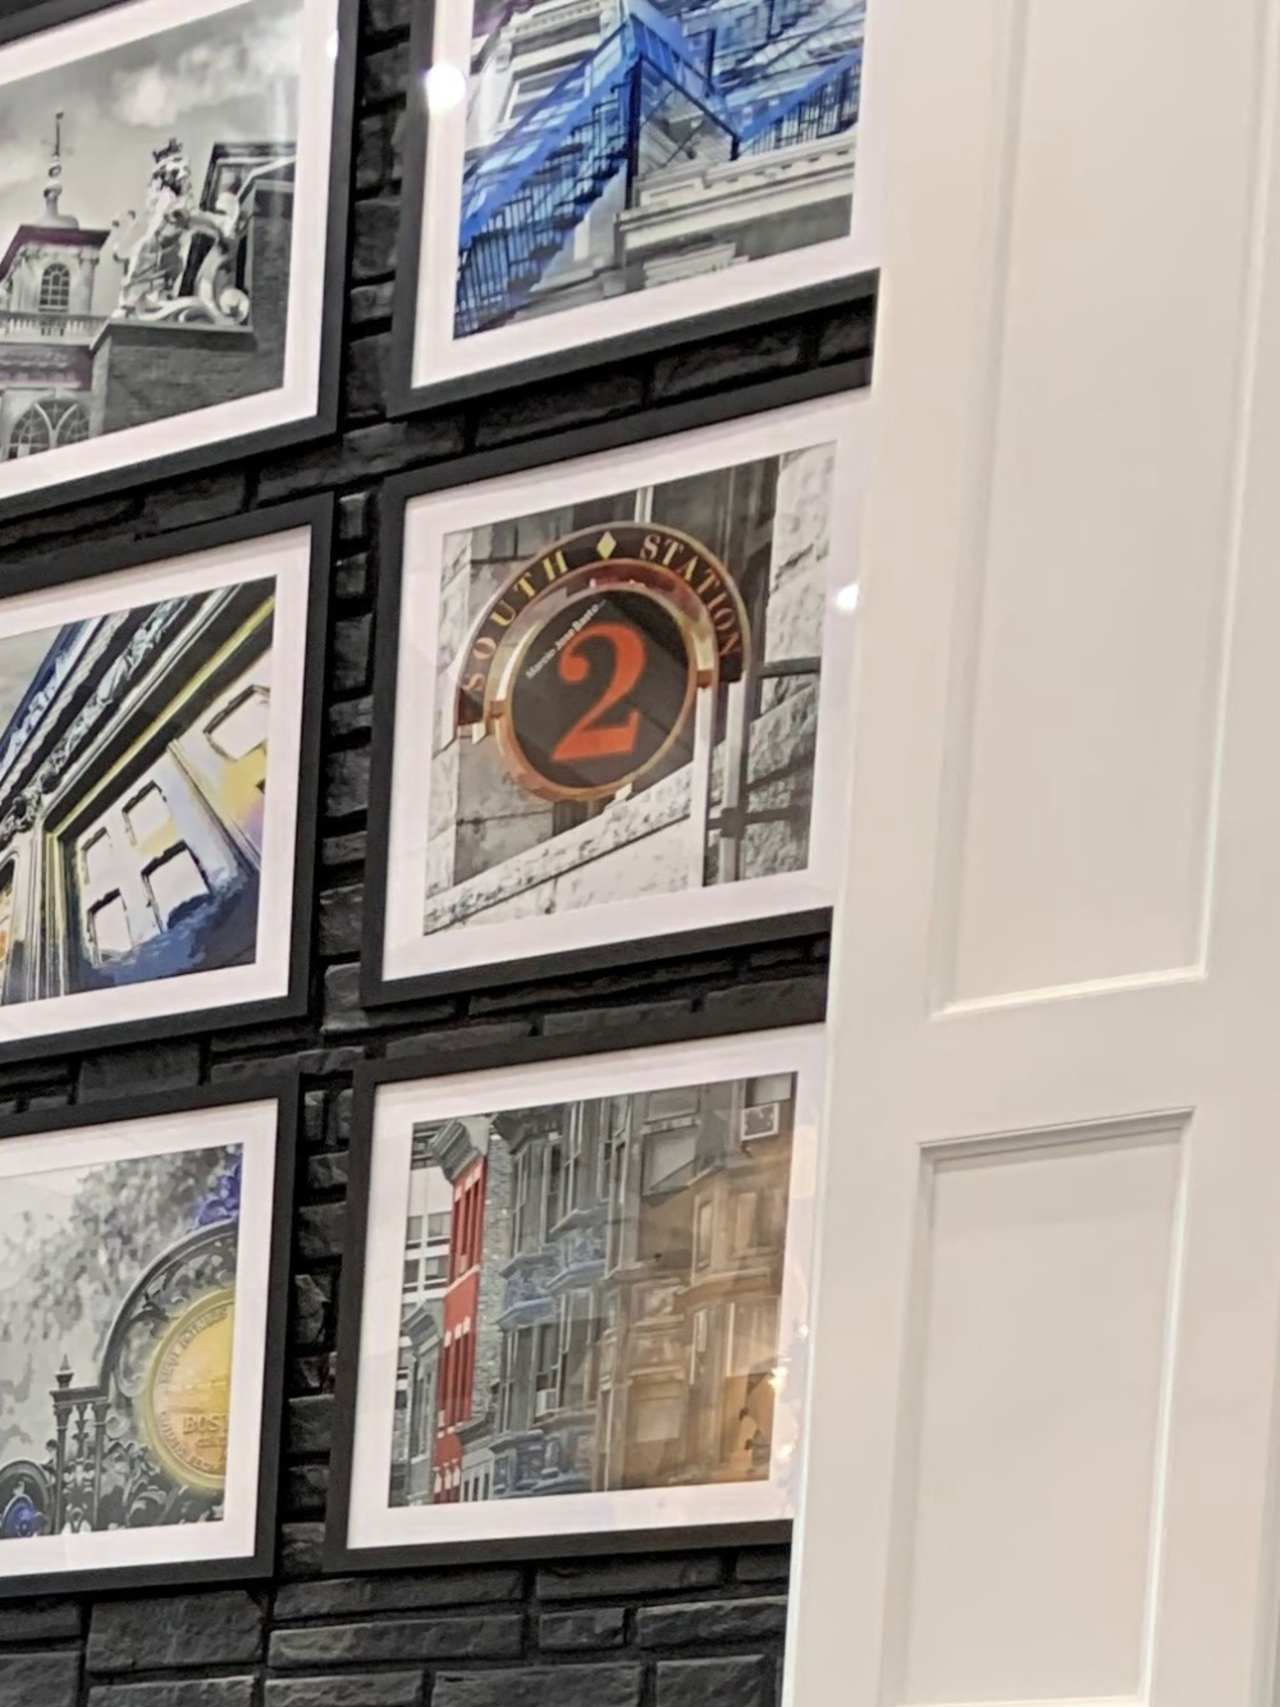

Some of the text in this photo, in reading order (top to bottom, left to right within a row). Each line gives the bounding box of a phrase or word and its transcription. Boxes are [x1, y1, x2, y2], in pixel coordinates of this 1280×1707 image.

[464, 533, 741, 692] SOUTH STATION
[549, 622, 648, 763] 2
